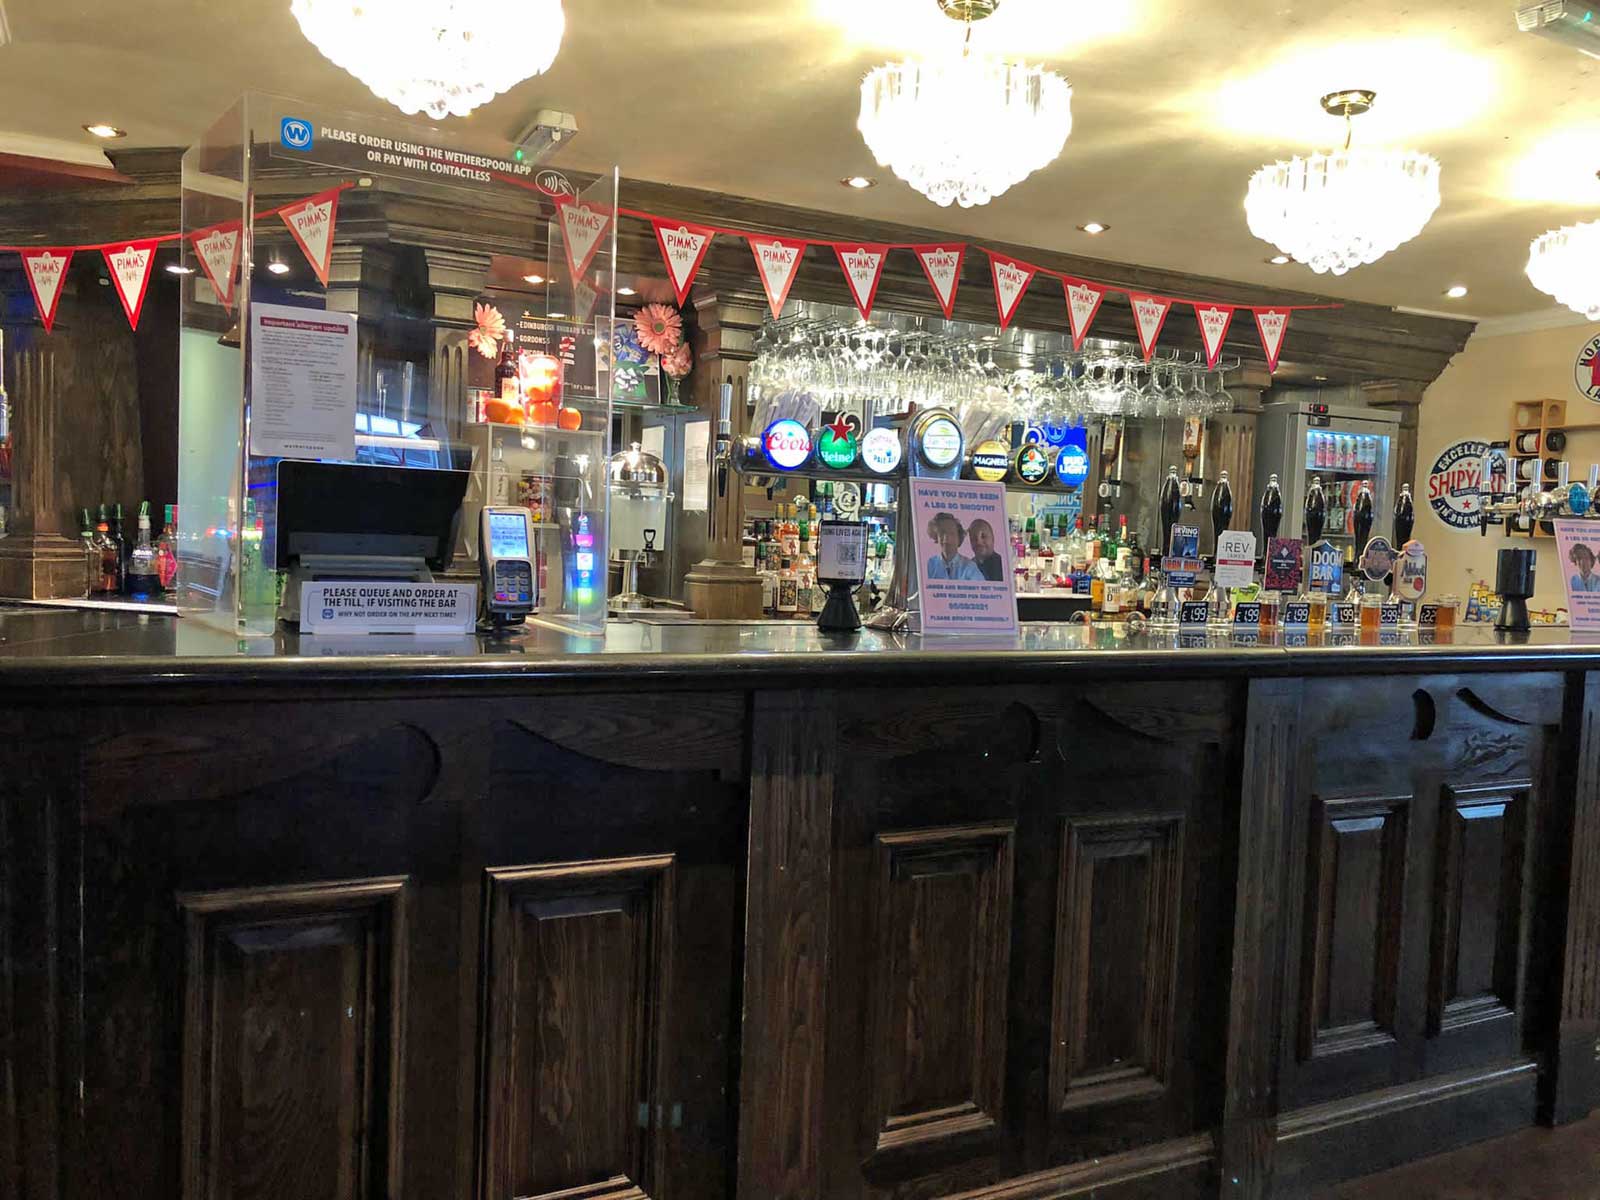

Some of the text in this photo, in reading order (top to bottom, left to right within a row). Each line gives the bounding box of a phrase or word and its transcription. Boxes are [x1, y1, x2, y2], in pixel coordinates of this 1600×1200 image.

[321, 127, 531, 175] PLEASE ORDER USING THE WETHERSPOON APP
[367, 151, 491, 182] OR PAY WITH CONTACTLESS
[297, 207, 328, 230] PIMM'S
[566, 212, 601, 231] PIMM'S
[666, 233, 699, 251] PIMM'S
[116, 253, 145, 269] PIMM'S
[762, 249, 793, 265] PIMM'S
[848, 255, 876, 270] PIMM'S
[928, 254, 956, 268] PIMM'S
[33, 260, 60, 274] PIMM'S
[999, 267, 1023, 284] PIMM'S
[1071, 289, 1095, 305] PIMM'S
[766, 431, 813, 452] Coors
[821, 449, 854, 463] Heine
[974, 456, 1007, 466] MAGNERS
[1063, 456, 1085, 465] BUD
[1060, 464, 1088, 475] LIGHT
[1225, 542, 1250, 553] REV
[1312, 565, 1333, 580] BAR
[323, 588, 459, 598] PLEASE QUEUE AND ORDER AT
[323, 598, 456, 608] THE TILL, IF VISITING THE BAR
